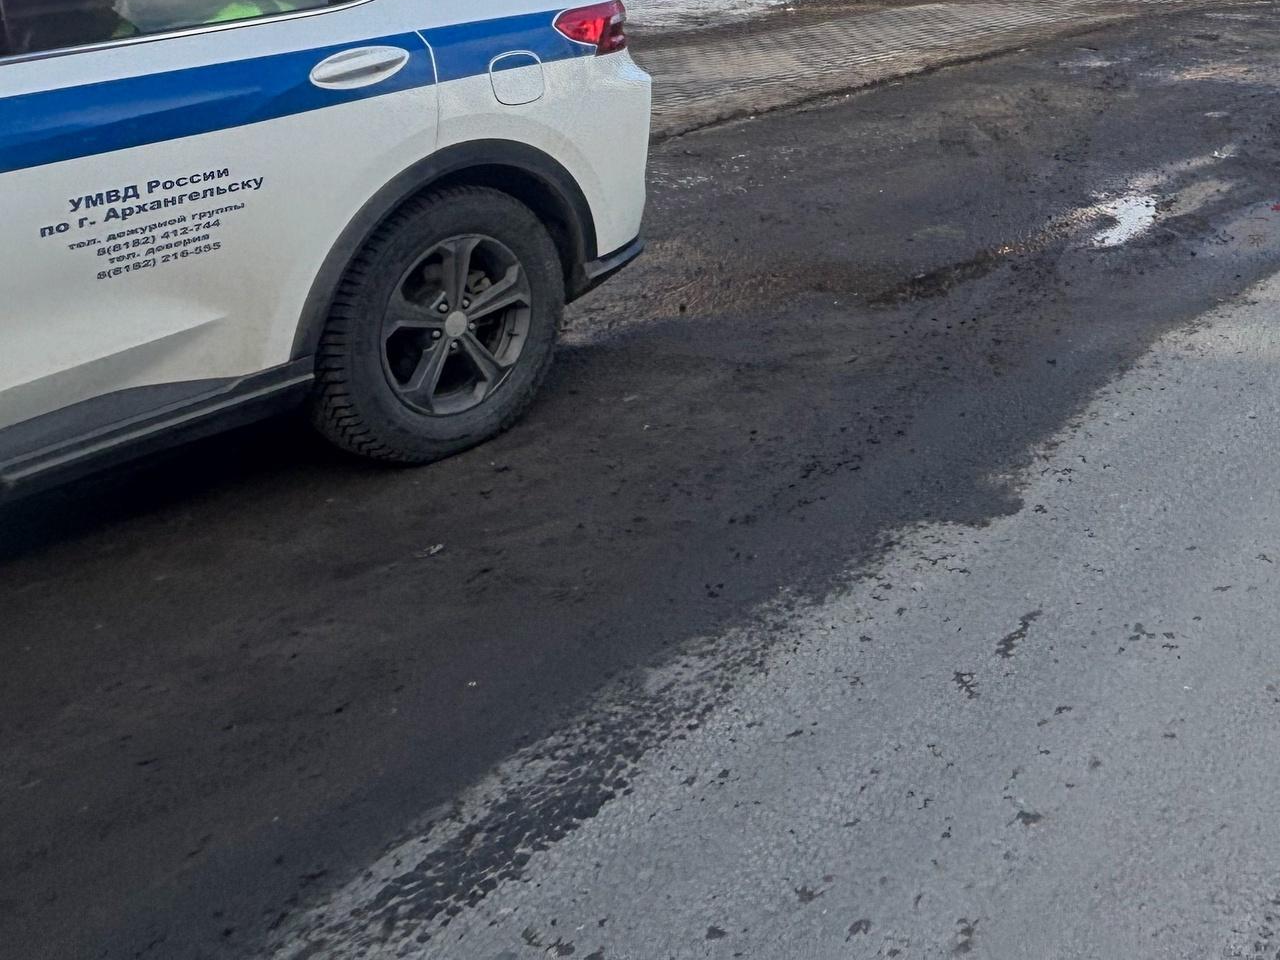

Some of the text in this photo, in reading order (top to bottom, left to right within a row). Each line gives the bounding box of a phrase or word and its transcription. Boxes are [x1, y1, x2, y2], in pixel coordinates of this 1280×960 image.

[40, 177, 264, 238] по г. Архангельску
[69, 168, 230, 212] УМВД России
[68, 202, 245, 250] тел. дежурной группы
[108, 233, 210, 264] тел. доверия
